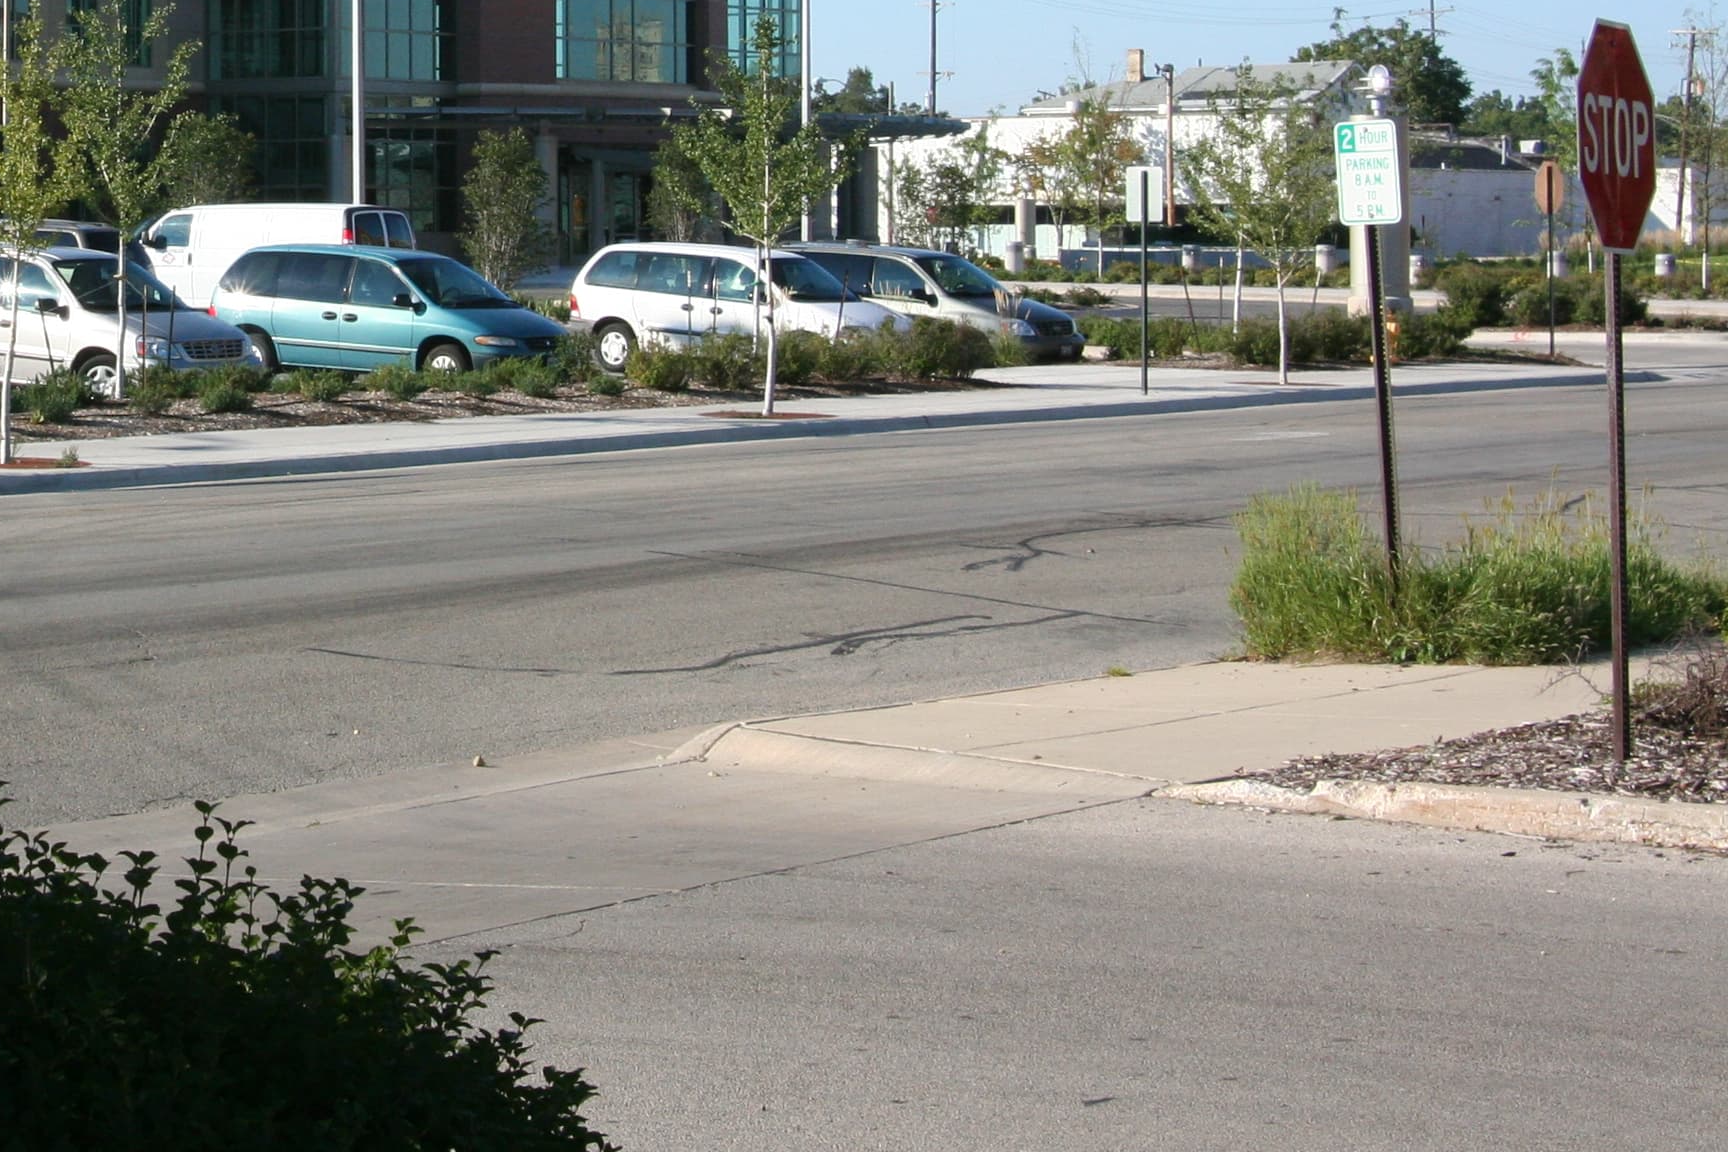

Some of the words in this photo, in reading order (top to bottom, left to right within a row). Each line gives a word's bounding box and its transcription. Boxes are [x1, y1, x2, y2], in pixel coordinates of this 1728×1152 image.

[1340, 128, 1353, 150] 2
[1359, 131, 1388, 145] HOUR
[1583, 91, 1649, 179] STOP
[1345, 157, 1390, 171] PARKING
[1354, 173, 1362, 186] 8
[1367, 190, 1377, 201] TO
[1356, 204, 1364, 217] 5
